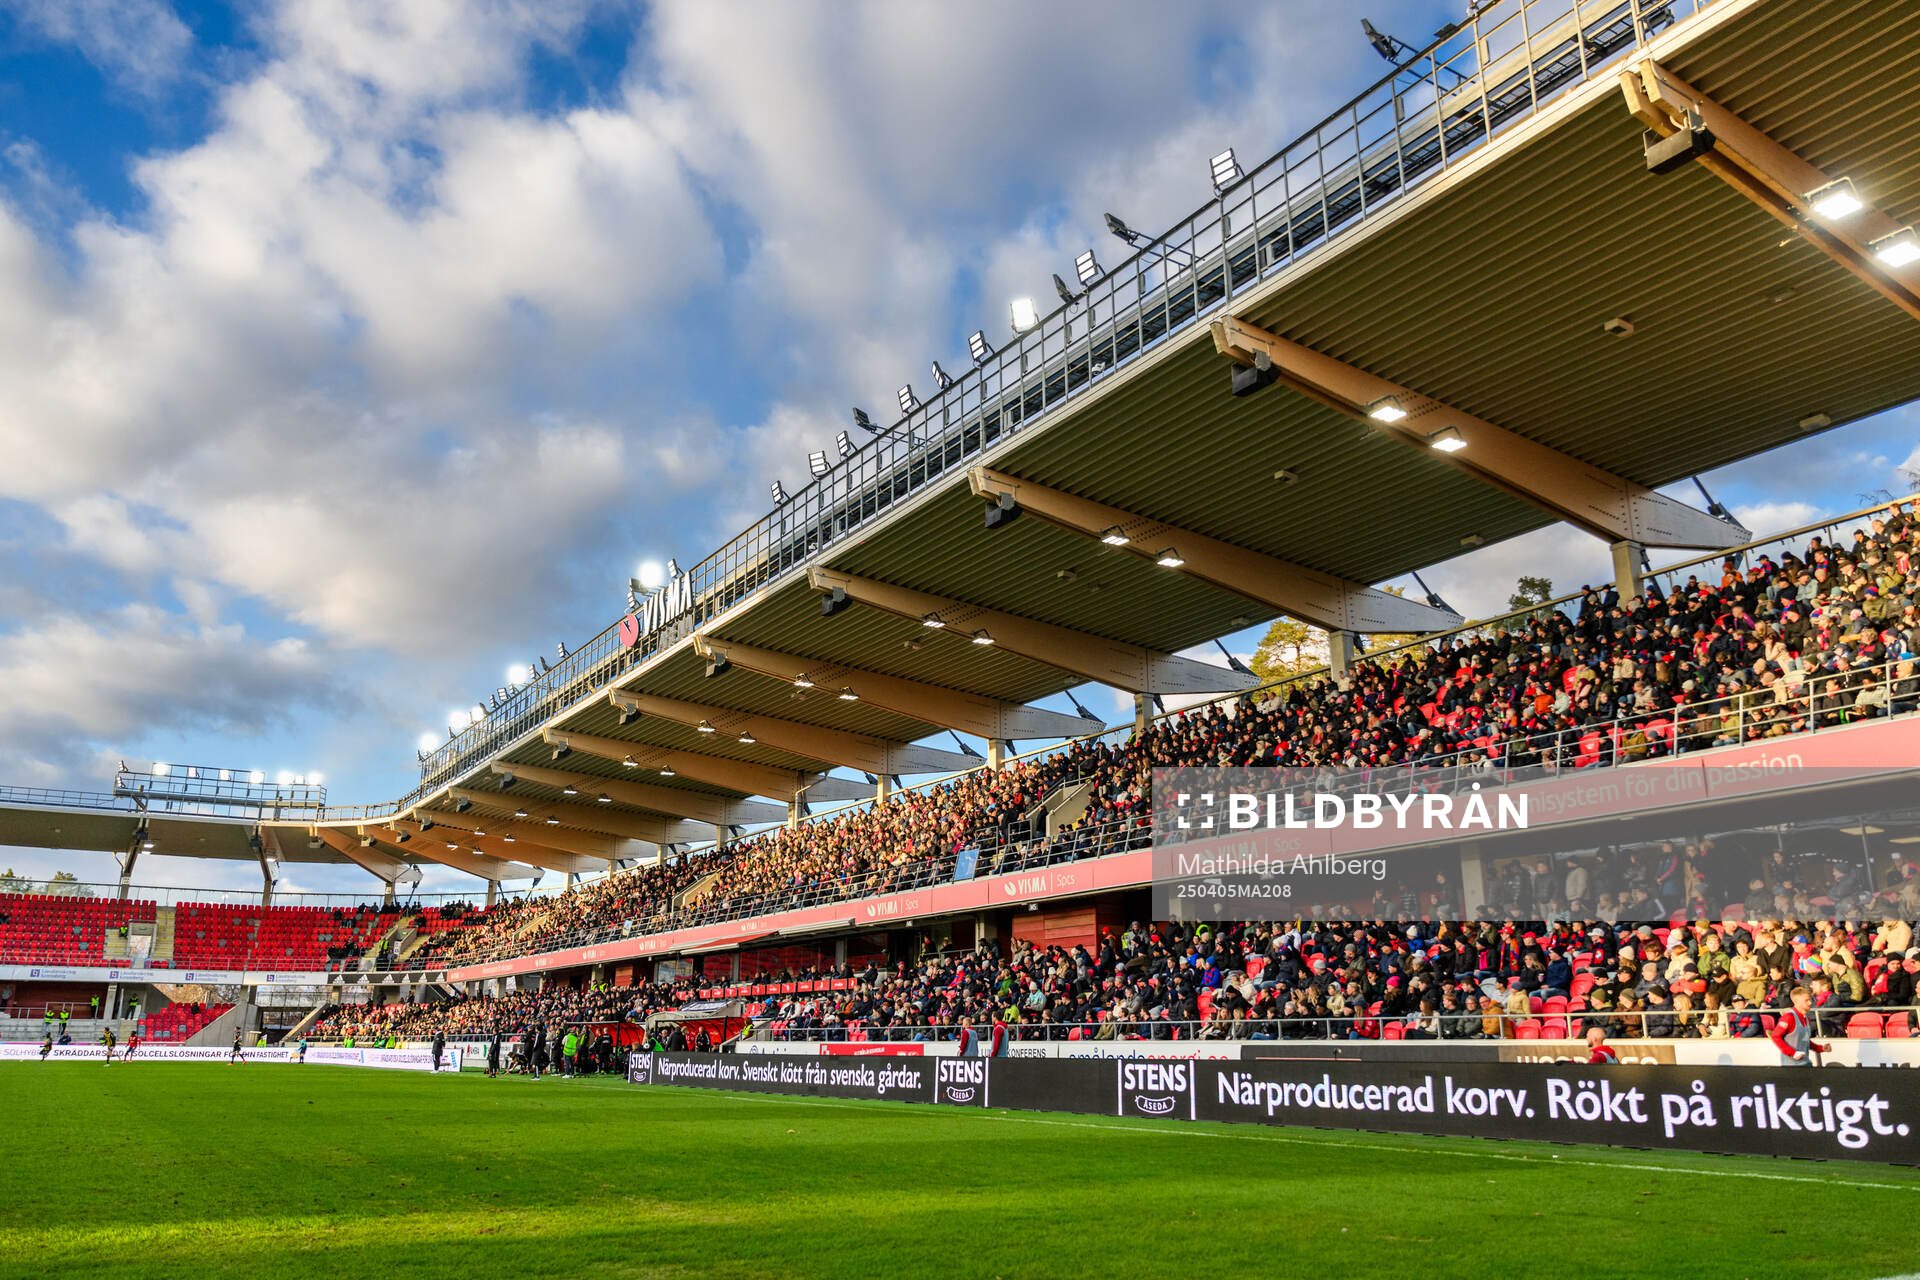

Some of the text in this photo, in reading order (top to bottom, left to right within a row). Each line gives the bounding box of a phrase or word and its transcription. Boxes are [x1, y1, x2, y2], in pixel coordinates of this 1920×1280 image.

[643, 571, 692, 637] VISMA
[1625, 774, 1656, 798] för
[1665, 765, 1702, 794] din
[1708, 752, 1804, 790] passion
[1018, 876, 1047, 895] VISMA
[631, 1054, 651, 1069] STENS
[658, 1058, 922, 1092] Närproducerad korv. Svenskt kött från svenska gårdar.
[939, 1060, 983, 1084] STENS
[1124, 1063, 1187, 1092] STENS
[1218, 1072, 1910, 1149] Närproducerad korv. Rökt på riktigt.
